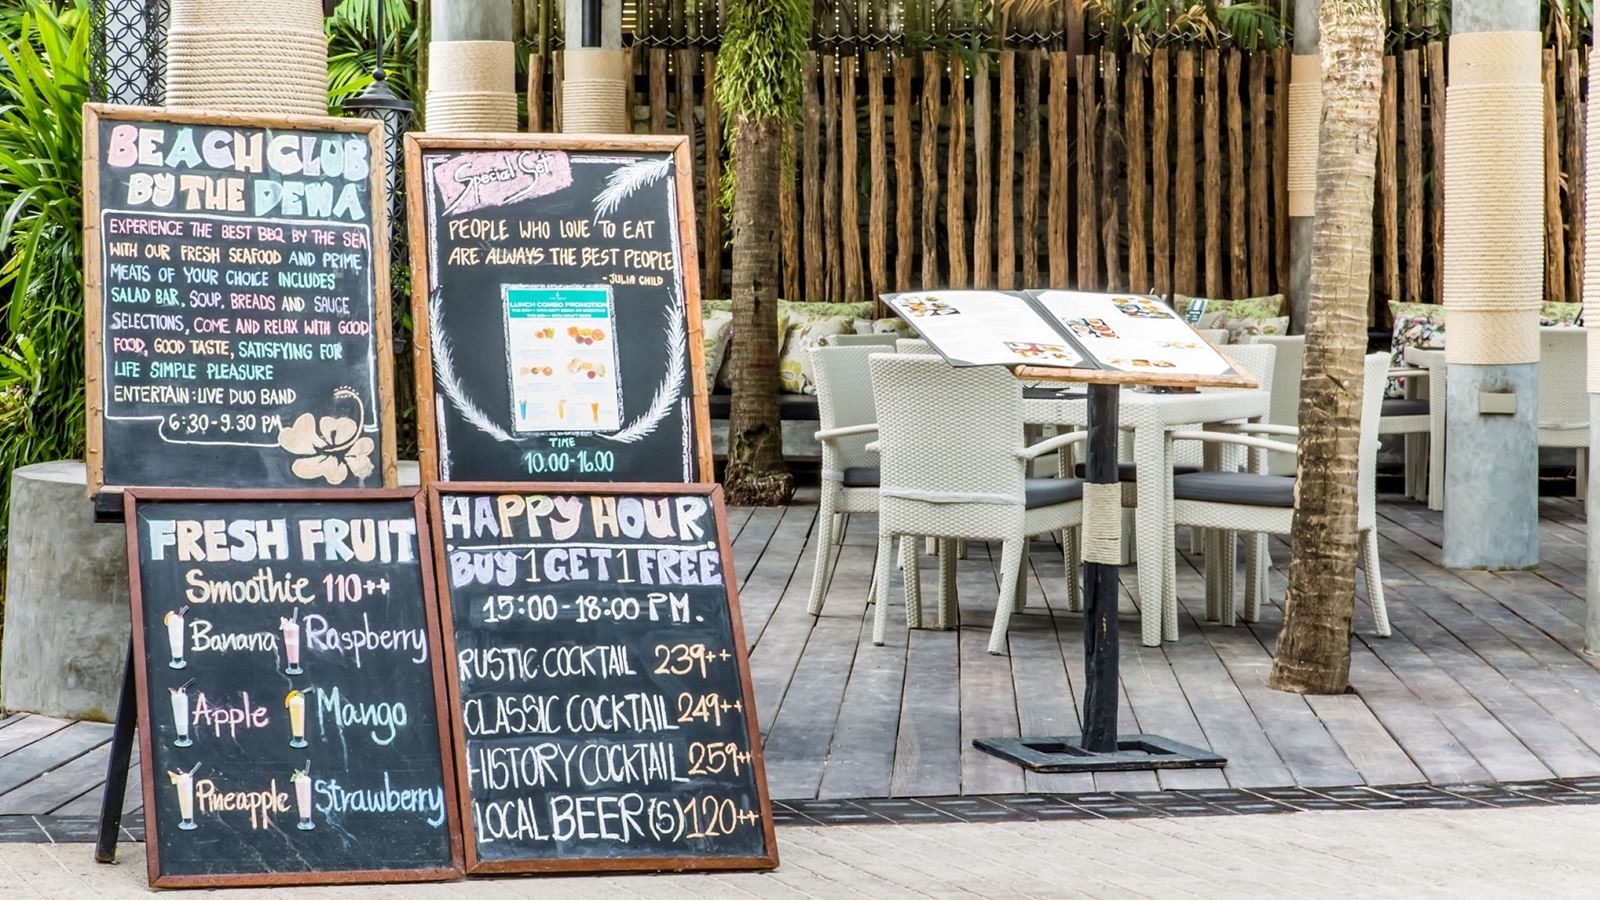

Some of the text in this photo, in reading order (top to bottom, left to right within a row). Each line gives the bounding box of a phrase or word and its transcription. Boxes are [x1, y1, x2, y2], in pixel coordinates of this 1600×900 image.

[107, 124, 370, 181] BEACH CLUB
[127, 173, 365, 221] BY THE DEWA
[442, 151, 555, 216] Special Set
[110, 219, 367, 250] EXPERIENCE THE BEST BBQ BY THE SEA
[448, 219, 656, 241] PEOPLE WHO LOVE TO EAT
[109, 242, 362, 270] WITH OUR FRESH SEAFOOD AND PRIME
[448, 247, 674, 271] ARE ALWAYS THE BEST PEOPLE
[111, 264, 336, 290] MEATS OF YOUR CHOICE INCLUDES
[638, 275, 664, 286] CHILD
[111, 286, 151, 304] SALAD
[230, 293, 276, 311] BREADS
[281, 296, 305, 312] AND
[314, 296, 351, 315] SAUCE
[111, 312, 370, 336] SELECTIONS, COME AND RELAX WITH GOOD
[114, 337, 343, 361] FOOD, GOOD TASTE, SATISFYING FOR
[114, 361, 274, 381] LIFE SIMPLE PLEASURE
[229, 389, 256, 405] DUO
[261, 388, 297, 405] BAND
[261, 415, 284, 433] PM
[548, 437, 576, 447] TIME
[442, 495, 708, 541] HAPPY HOUR
[149, 518, 416, 562] FRESH FRUIT
[185, 566, 390, 604] Smoothie 110++
[450, 548, 723, 588] BUY 1 GET 1 FREE
[189, 612, 428, 669] Banana Raspberry
[458, 643, 731, 682] RUSTIC COCKTAIL 239++
[192, 686, 408, 745] Apple Mango
[463, 692, 742, 735] CLASSIC COCKTAIL 249++
[466, 741, 752, 790] HISTORY COCKTAIL 259++
[195, 771, 445, 830] Pineapple Strawberry
[473, 797, 549, 843] LOCAL
[683, 795, 759, 839] 120++
